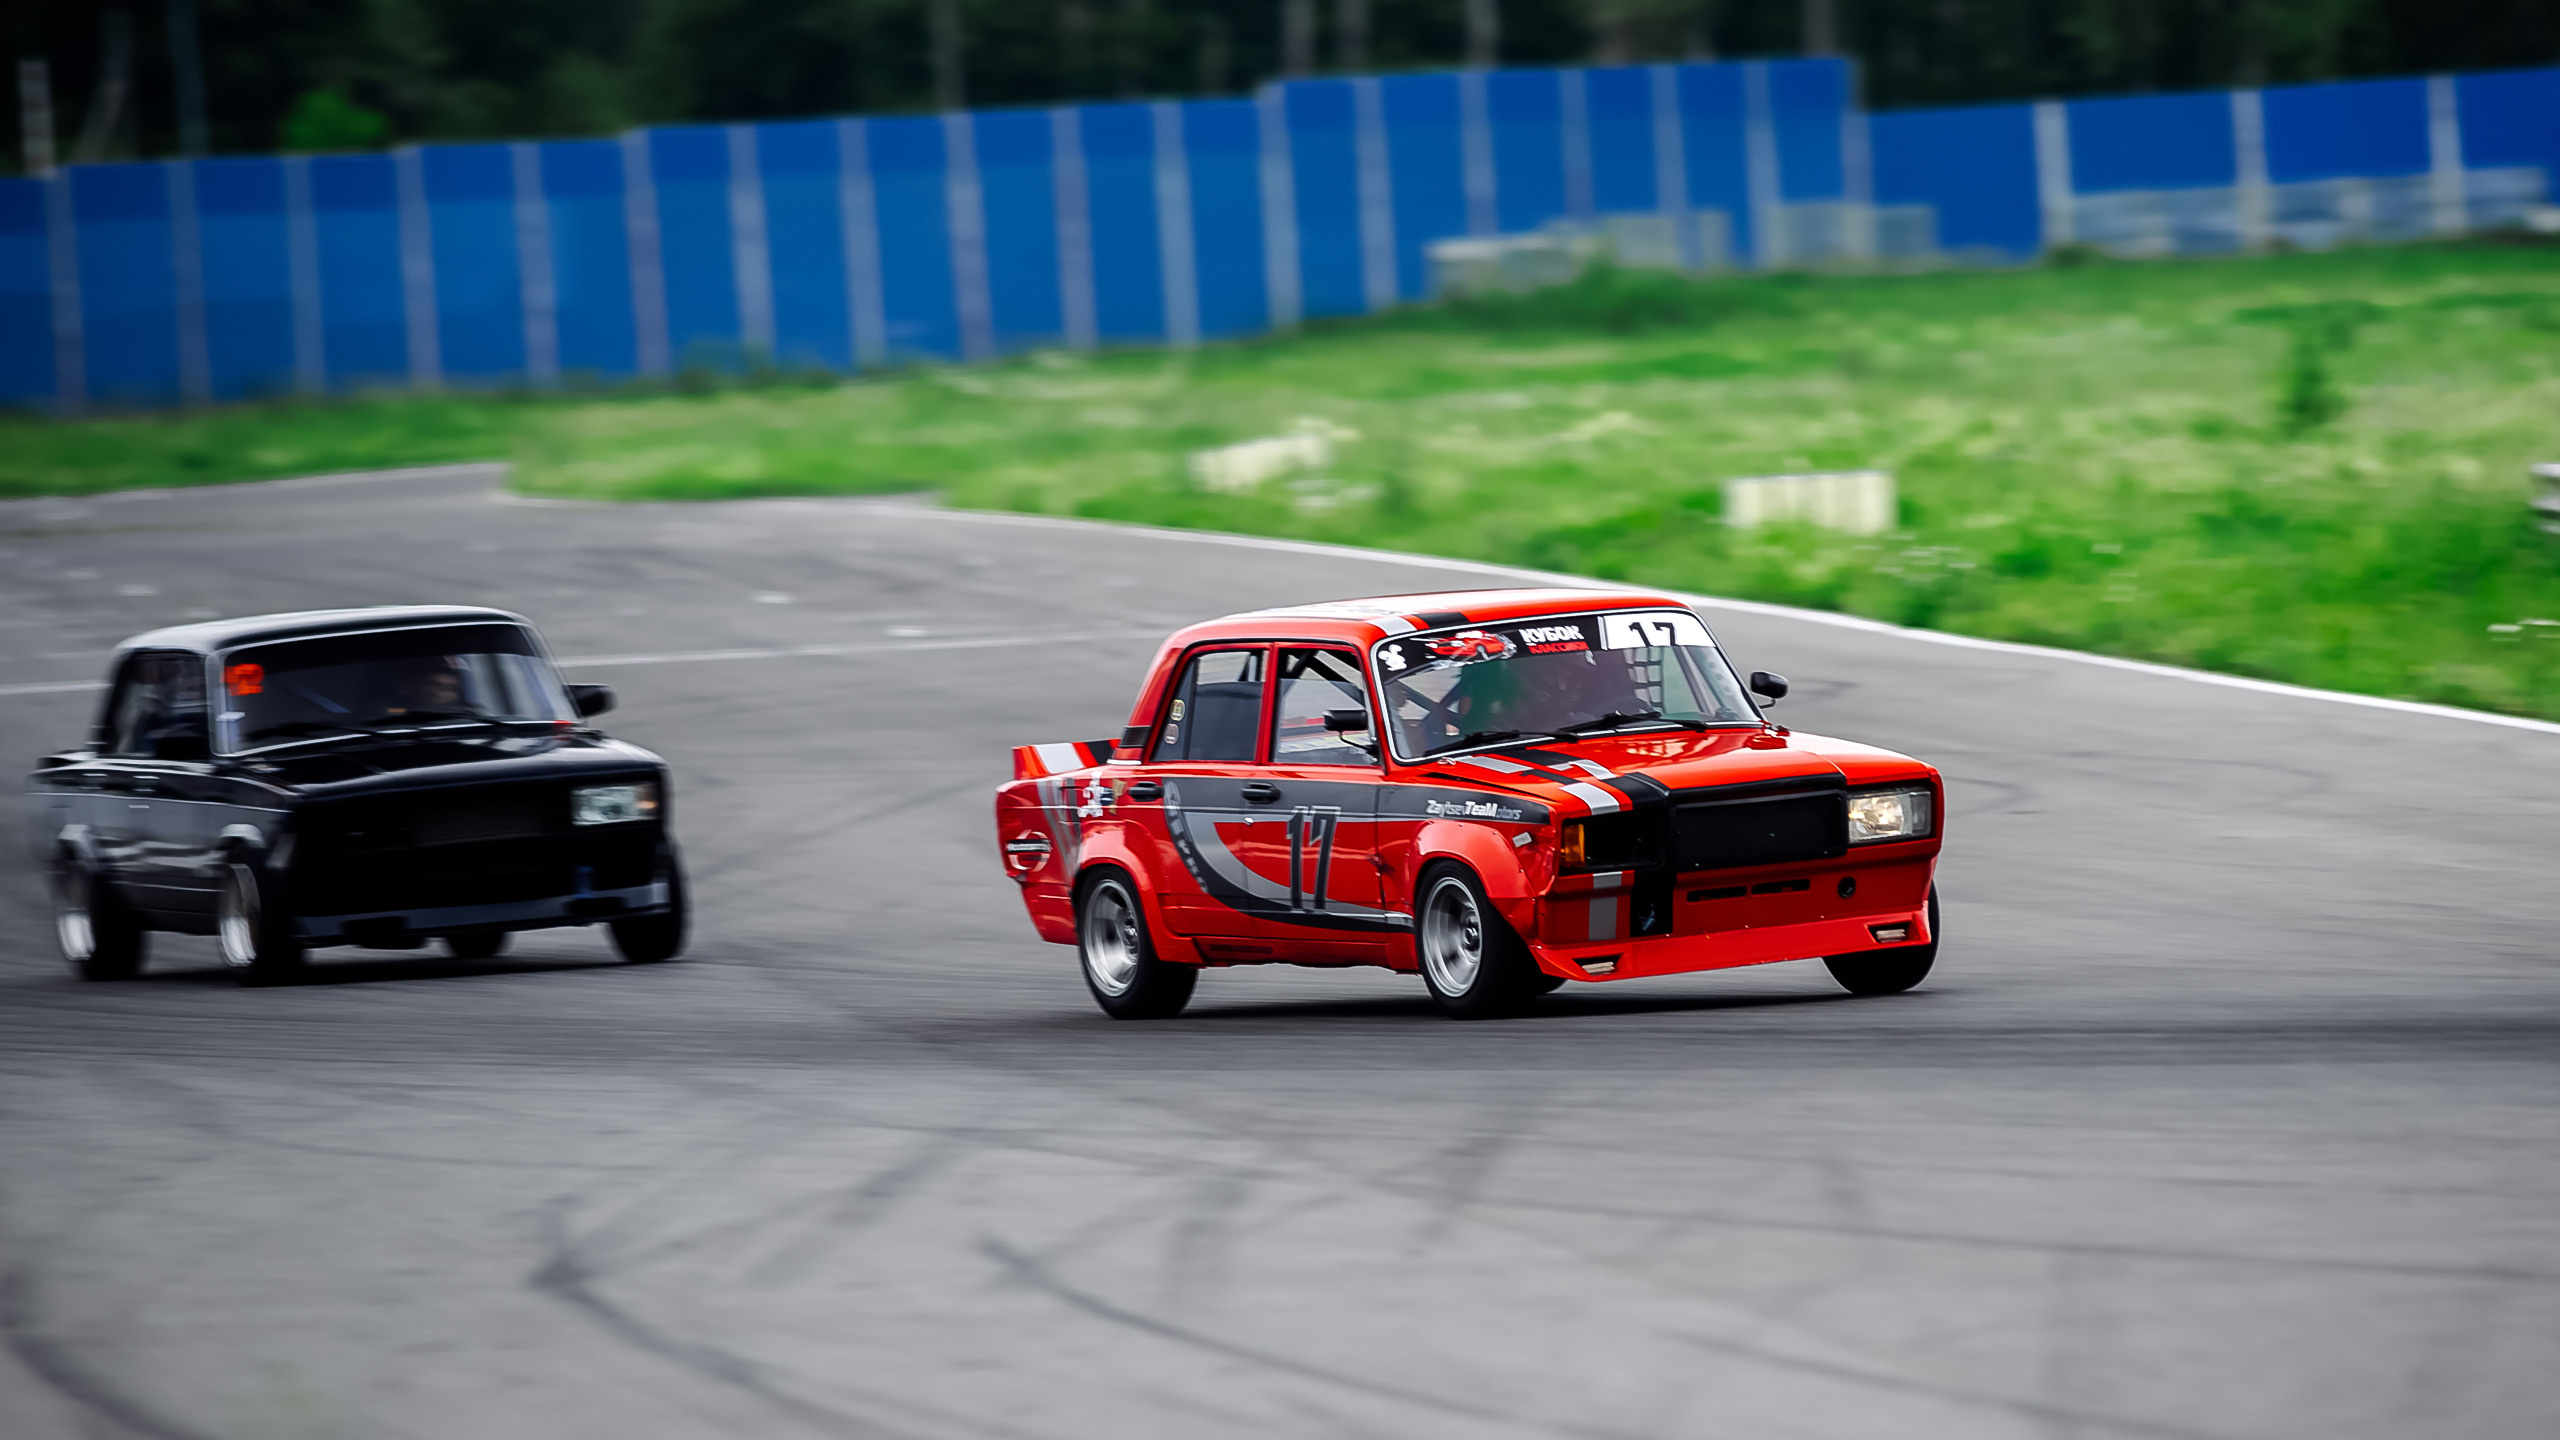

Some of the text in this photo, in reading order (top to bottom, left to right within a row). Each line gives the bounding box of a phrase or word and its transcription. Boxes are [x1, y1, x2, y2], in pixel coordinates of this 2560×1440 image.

[1518, 625, 1584, 643] КУБОК
[1628, 622, 1680, 647] 17
[1286, 805, 1341, 914] 17
